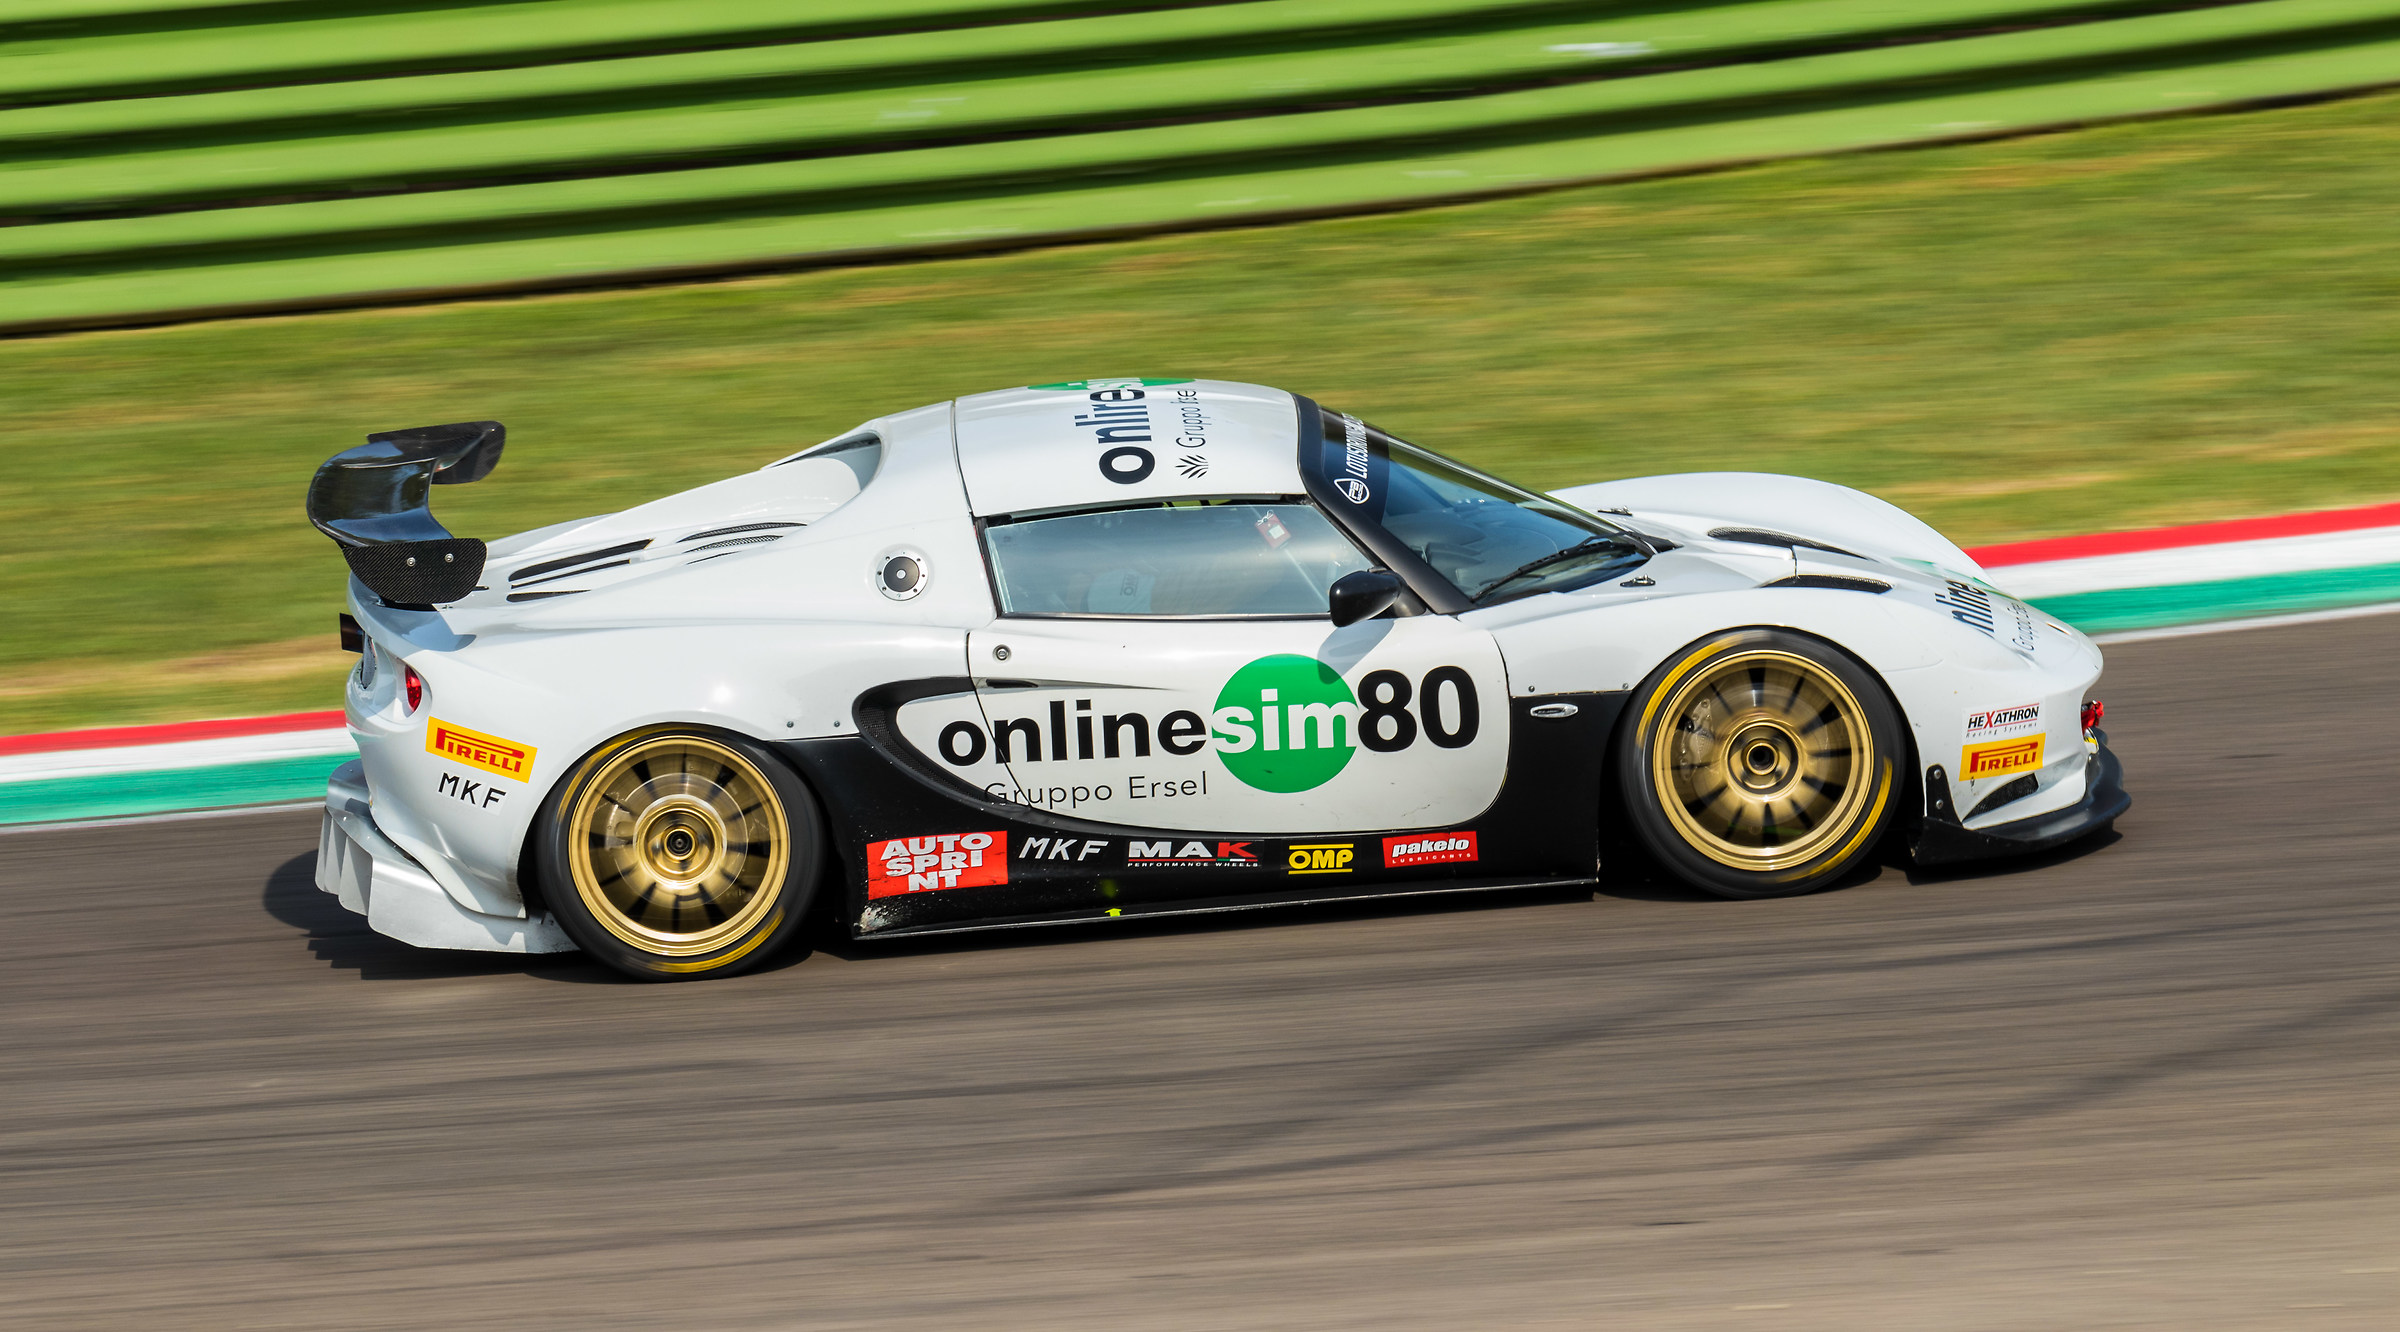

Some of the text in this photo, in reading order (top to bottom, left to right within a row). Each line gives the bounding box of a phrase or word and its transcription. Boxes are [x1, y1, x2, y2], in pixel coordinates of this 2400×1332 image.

[1176, 407, 1212, 448] Gruppo
[1358, 665, 1480, 753] 80
[435, 727, 525, 773] PIRELLI
[1969, 741, 2039, 773] PIRELLI
[438, 772, 507, 808] MKF
[984, 770, 1207, 809] Gruppo Ersel
[880, 832, 993, 861] AUTO
[1018, 836, 1109, 862] MKF
[1128, 841, 1258, 858] MAK
[1288, 849, 1354, 870] OMP
[1391, 837, 1470, 858] pakelo
[1392, 852, 1472, 864] LUBRICANTS
[885, 850, 983, 877] SPRI
[908, 869, 962, 892] NT
